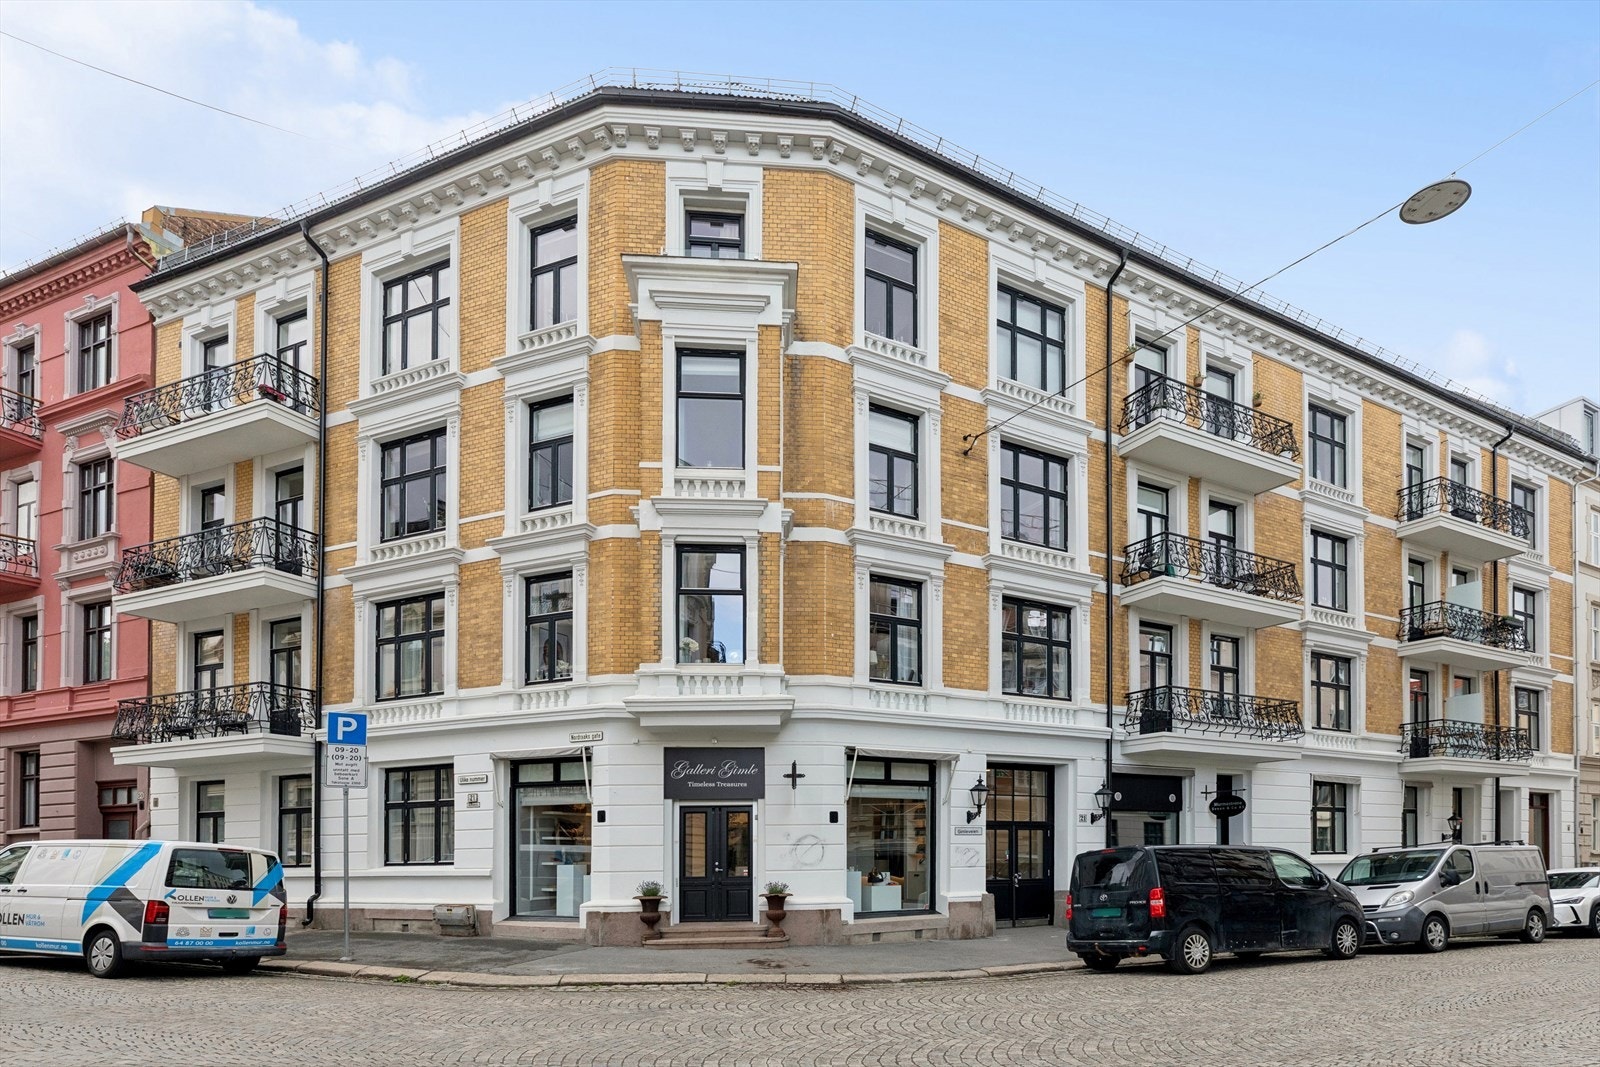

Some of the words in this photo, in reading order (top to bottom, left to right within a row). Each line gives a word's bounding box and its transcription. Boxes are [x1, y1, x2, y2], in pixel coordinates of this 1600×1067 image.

[337, 716, 358, 741] P
[670, 760, 717, 779] Galleri
[717, 760, 759, 779] Gimle
